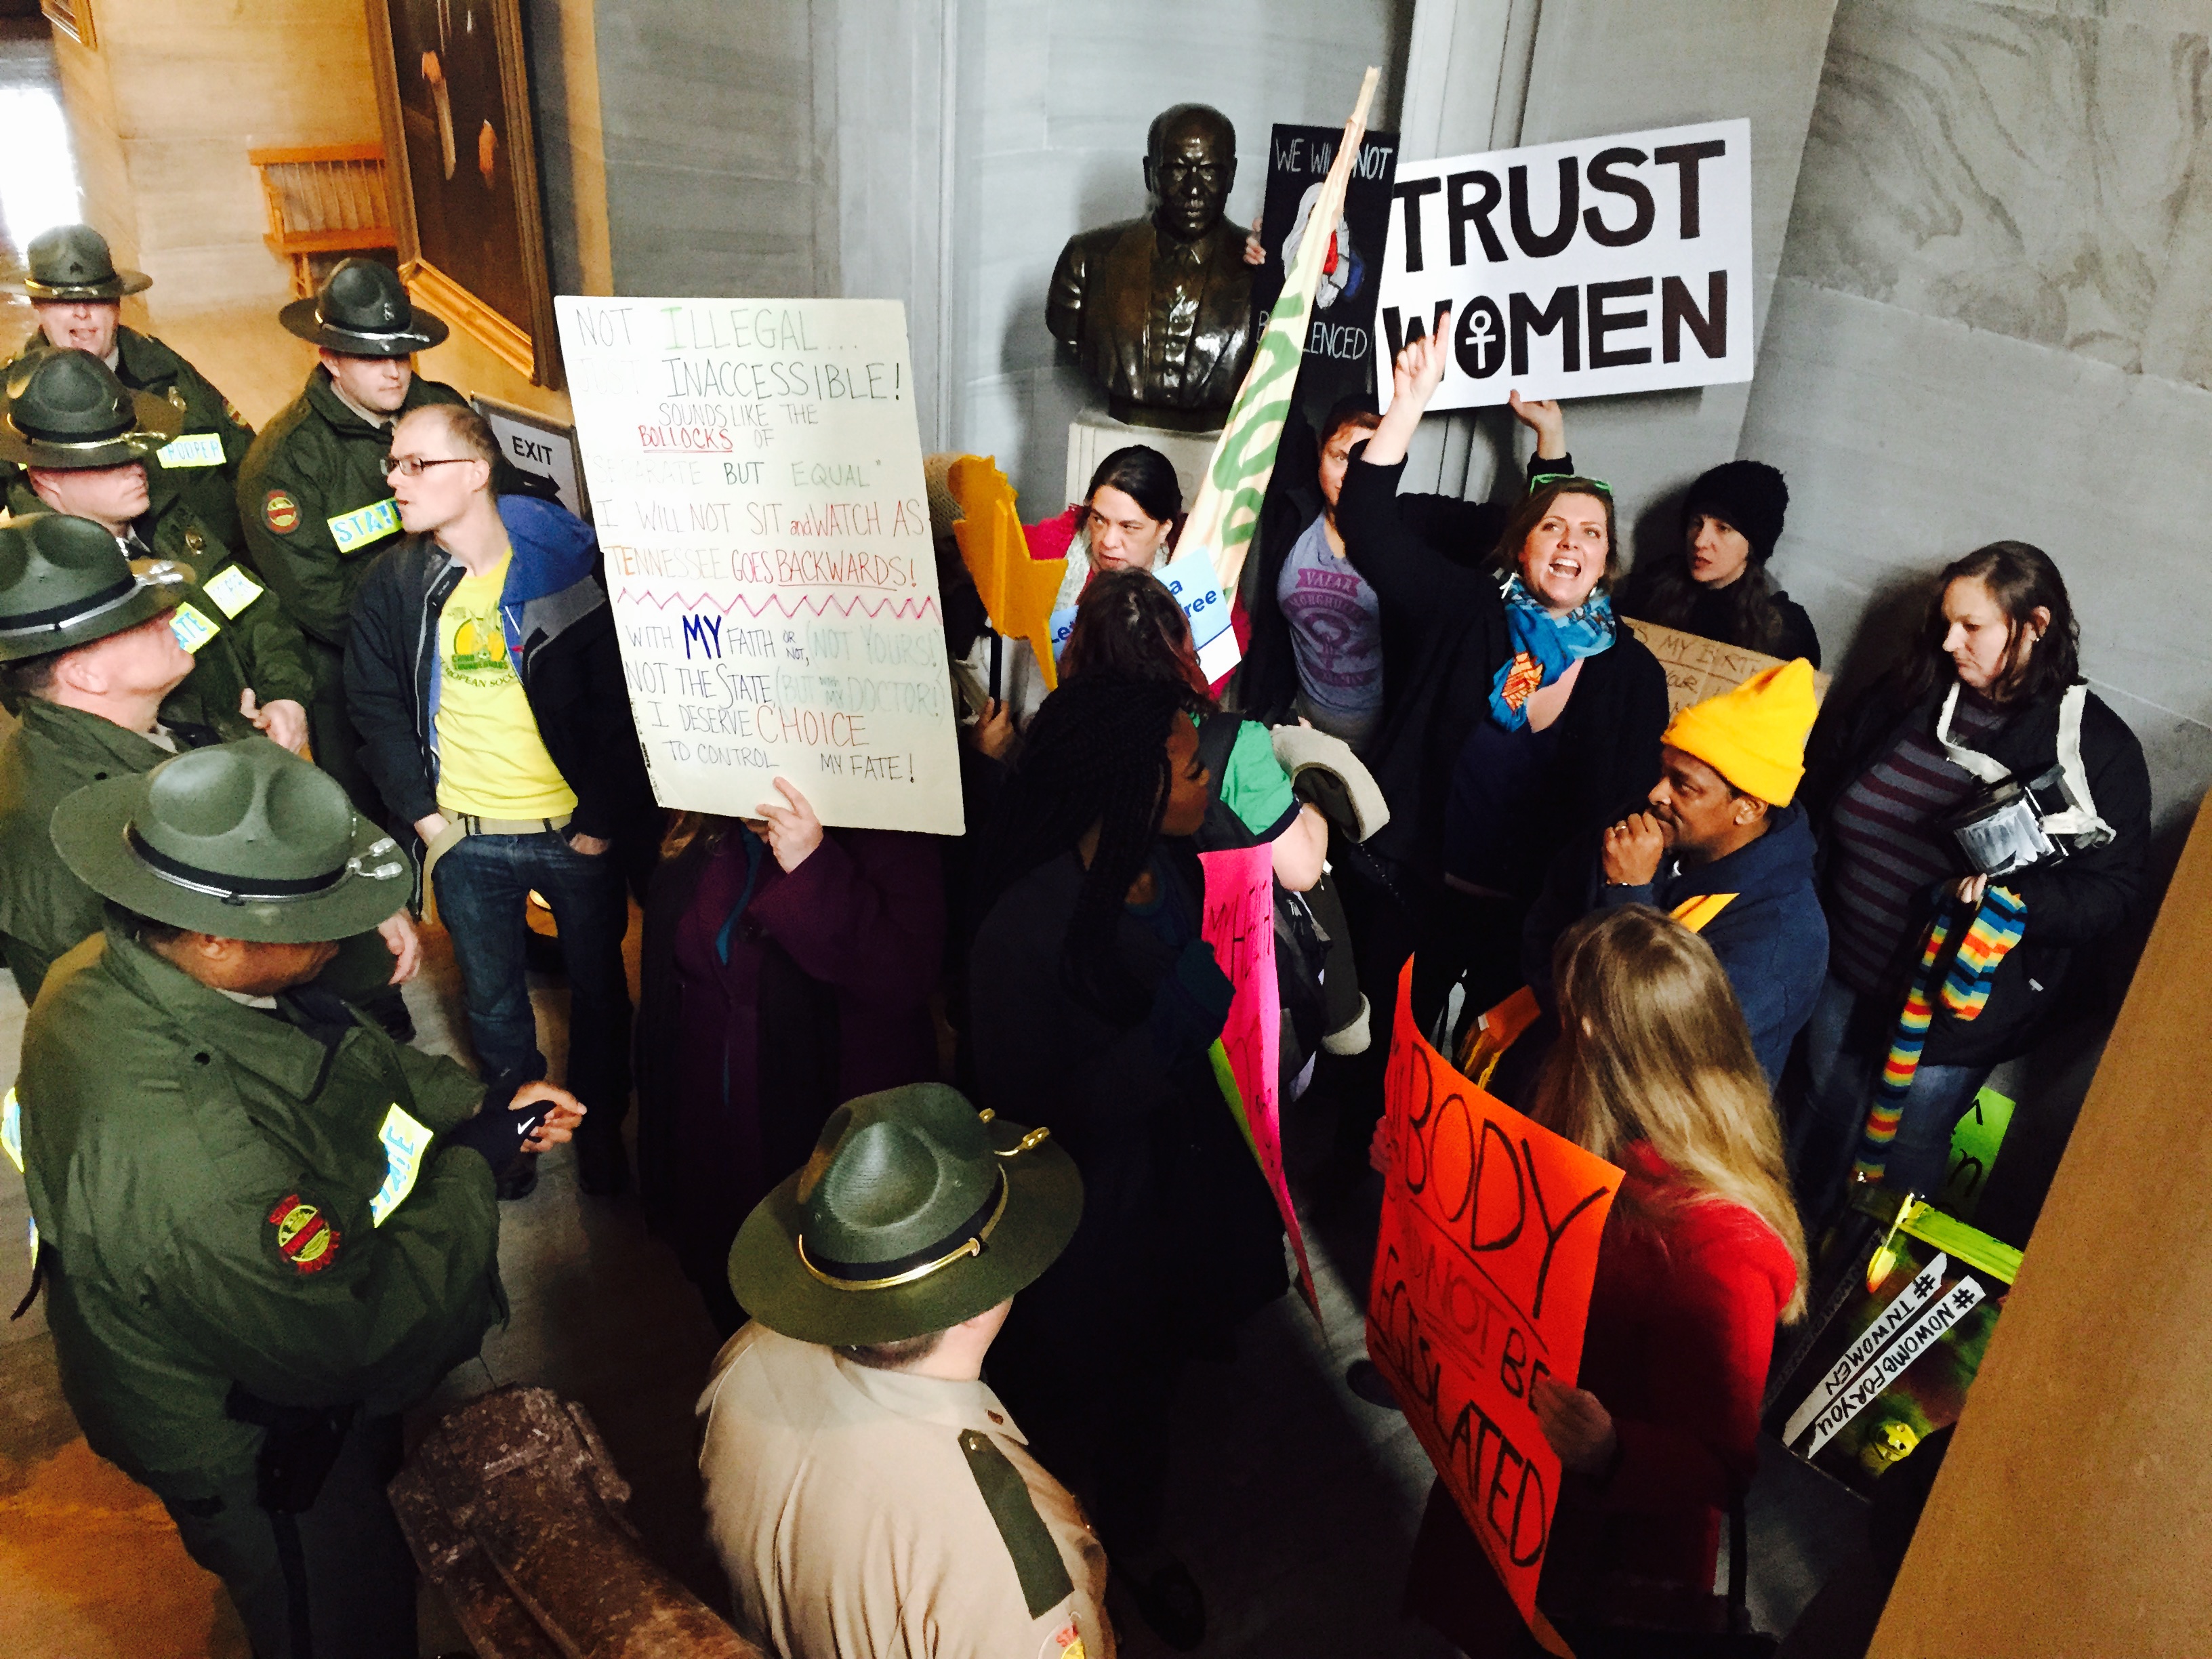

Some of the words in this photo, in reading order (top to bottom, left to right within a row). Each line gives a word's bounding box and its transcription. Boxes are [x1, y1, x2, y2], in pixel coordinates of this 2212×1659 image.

[1275, 138, 1305, 172] WE
[1353, 143, 1393, 180] NOT
[1393, 139, 1725, 273] TRUST
[576, 308, 633, 346] NOT
[1382, 269, 1727, 383] WOMEN
[571, 358, 639, 394] JUST
[662, 357, 899, 401] INACCESSIBLE!
[658, 403, 727, 428] SOUNDS
[731, 403, 769, 427] LIKE
[779, 403, 819, 425] THE
[512, 435, 552, 466] EXIT
[638, 425, 733, 450] BOLLOCKS
[754, 428, 775, 449] OF
[724, 461, 764, 485] BUT
[596, 499, 619, 527] I
[635, 501, 684, 533] WILL
[690, 502, 731, 533] NOT
[747, 503, 782, 536] SIT
[791, 510, 811, 536] and
[811, 502, 881, 537] WATCH
[893, 499, 924, 537] AS
[604, 544, 729, 580] TENNESSEE
[732, 550, 774, 583] GOES
[777, 550, 917, 587] BACKWARDS!
[626, 625, 673, 649] WITH
[682, 614, 722, 660] MY
[727, 628, 777, 658] FAITH
[783, 630, 796, 643] OR
[1660, 634, 1696, 662] MY
[625, 660, 668, 695] NOT
[675, 667, 713, 699] THE
[825, 690, 844, 709] MY
[647, 701, 669, 728] I
[678, 707, 753, 737] DESERVE
[756, 705, 869, 747] CHOICE
[662, 739, 690, 762] TO
[698, 747, 780, 769] CONTROL
[821, 753, 842, 773] MY
[850, 752, 915, 783] FATE!
[1406, 1042, 1609, 1319] BODY
